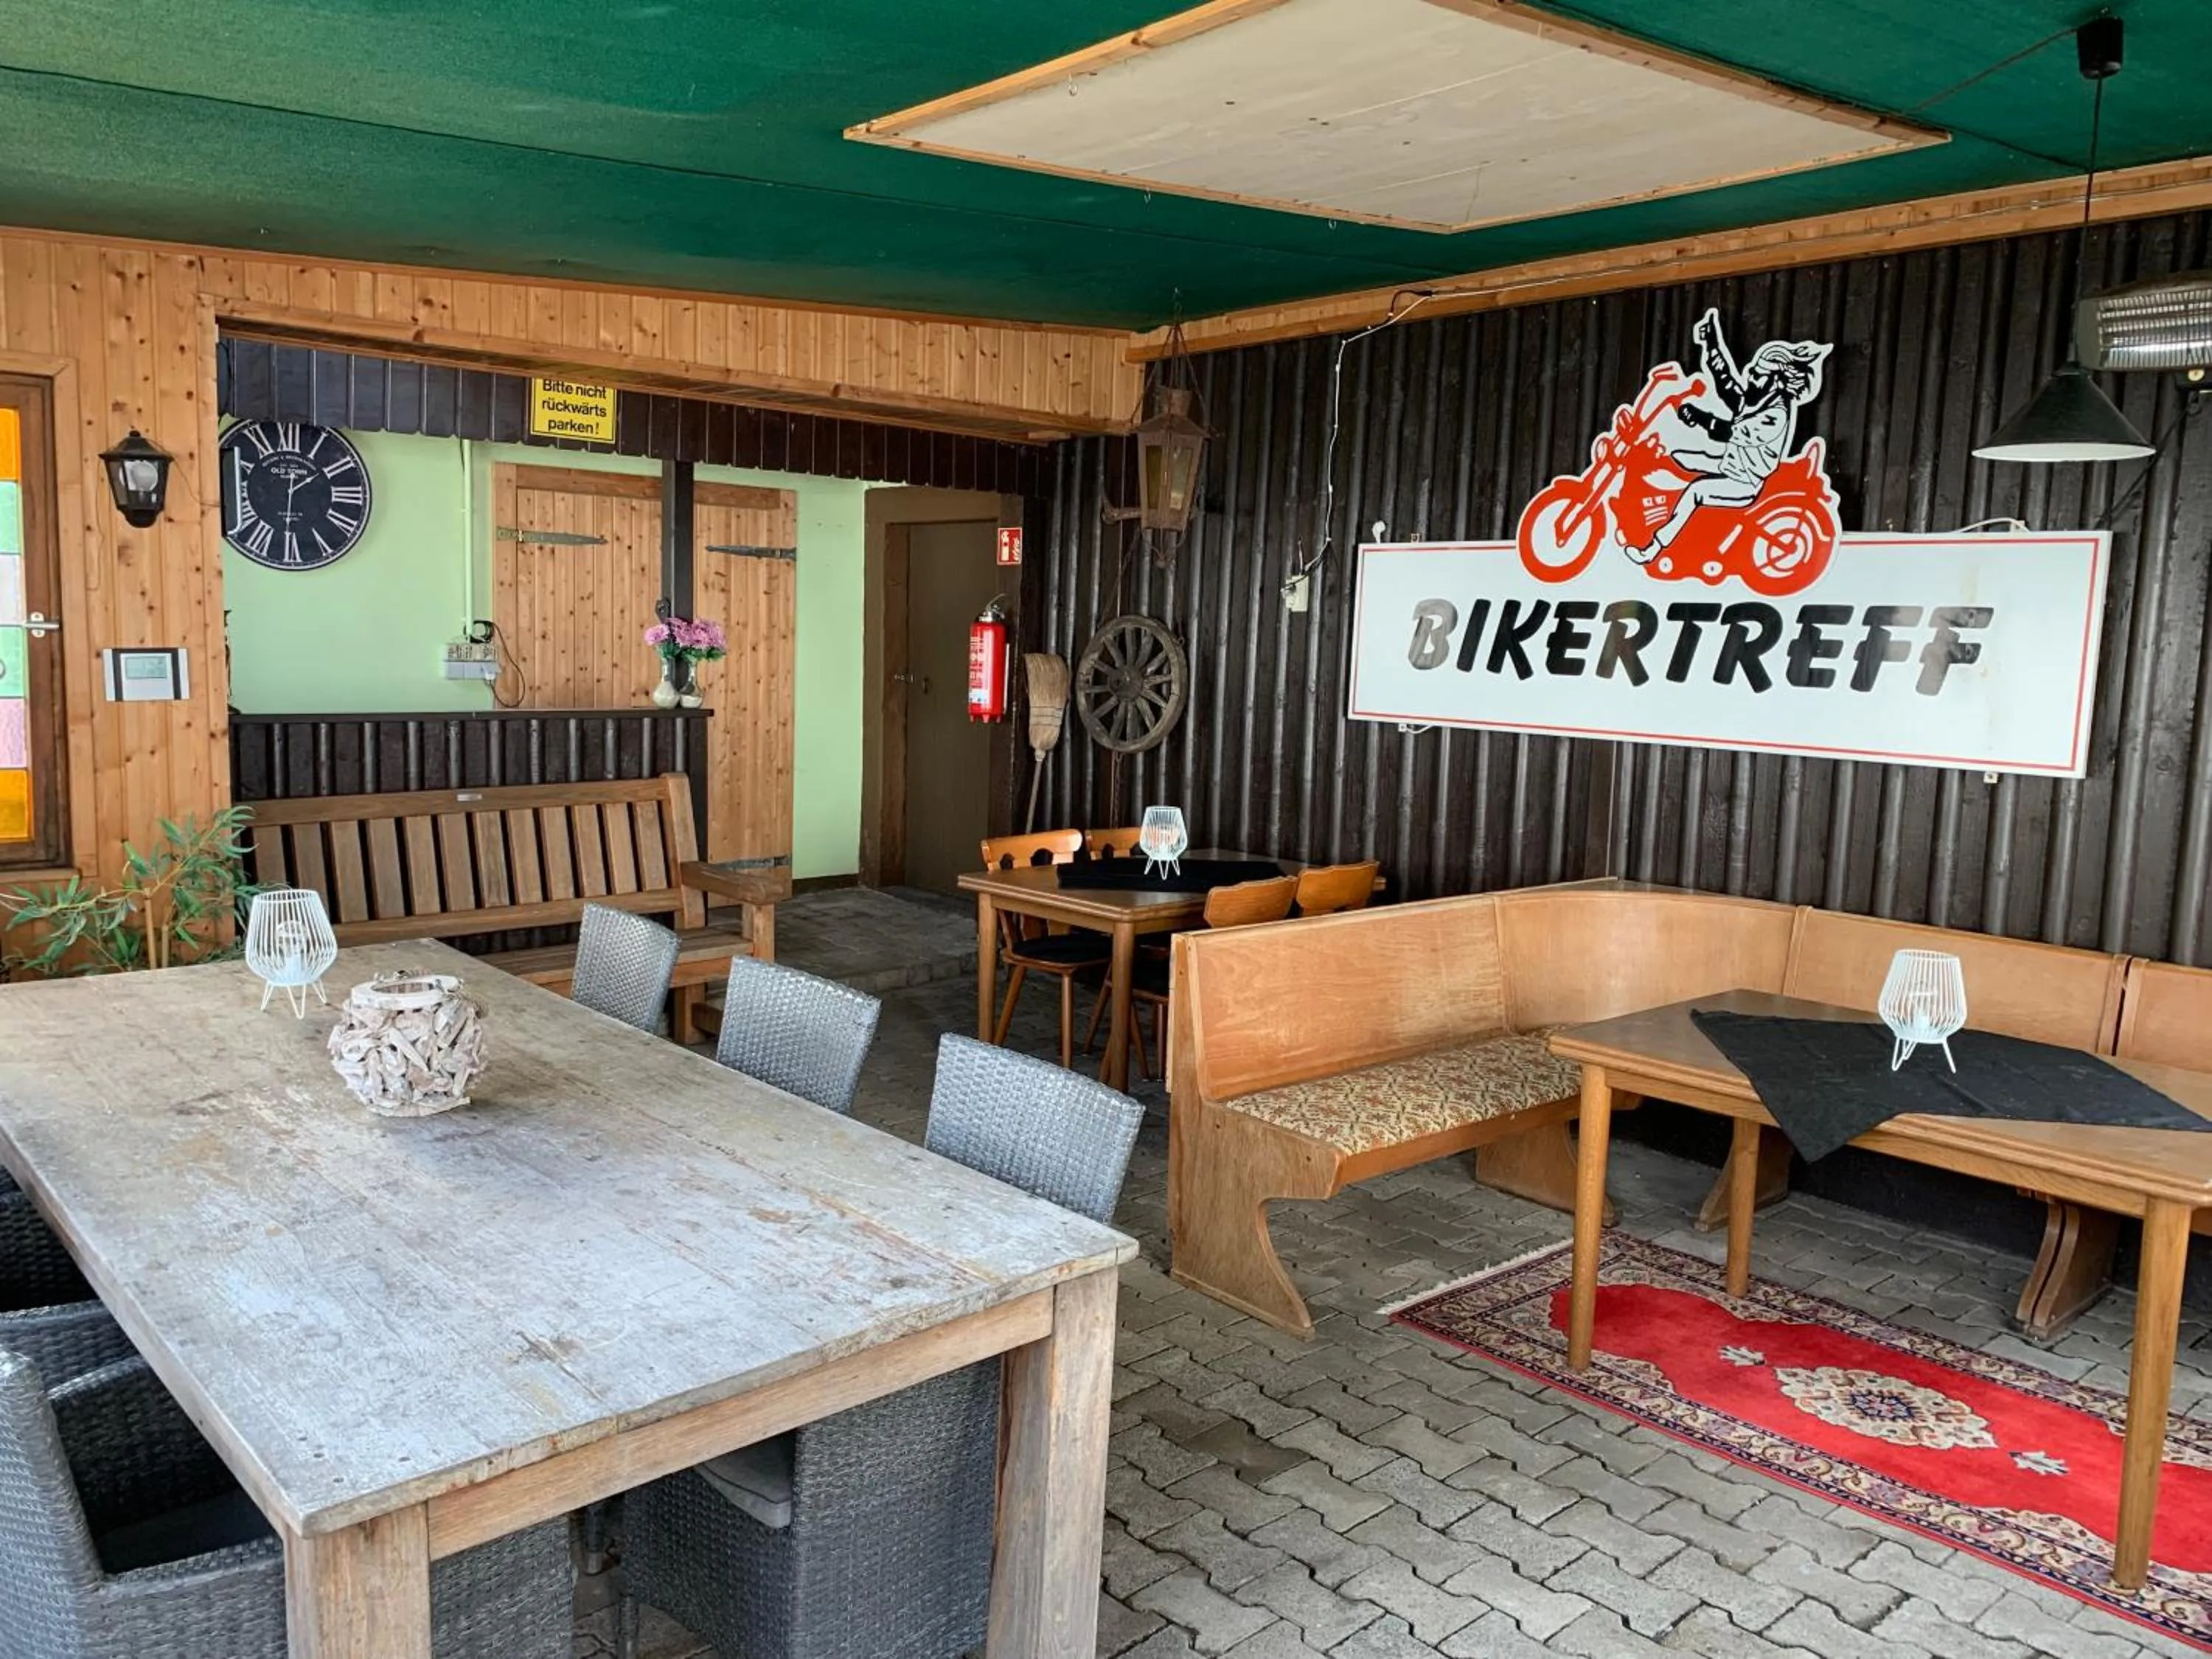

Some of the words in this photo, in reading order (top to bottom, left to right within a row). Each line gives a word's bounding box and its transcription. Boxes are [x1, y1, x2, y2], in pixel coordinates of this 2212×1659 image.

[543, 379, 574, 394] Bitte
[576, 383, 607, 399] nicht
[542, 397, 607, 417] rückwärts
[1407, 598, 1994, 696] BIKERTREFF
